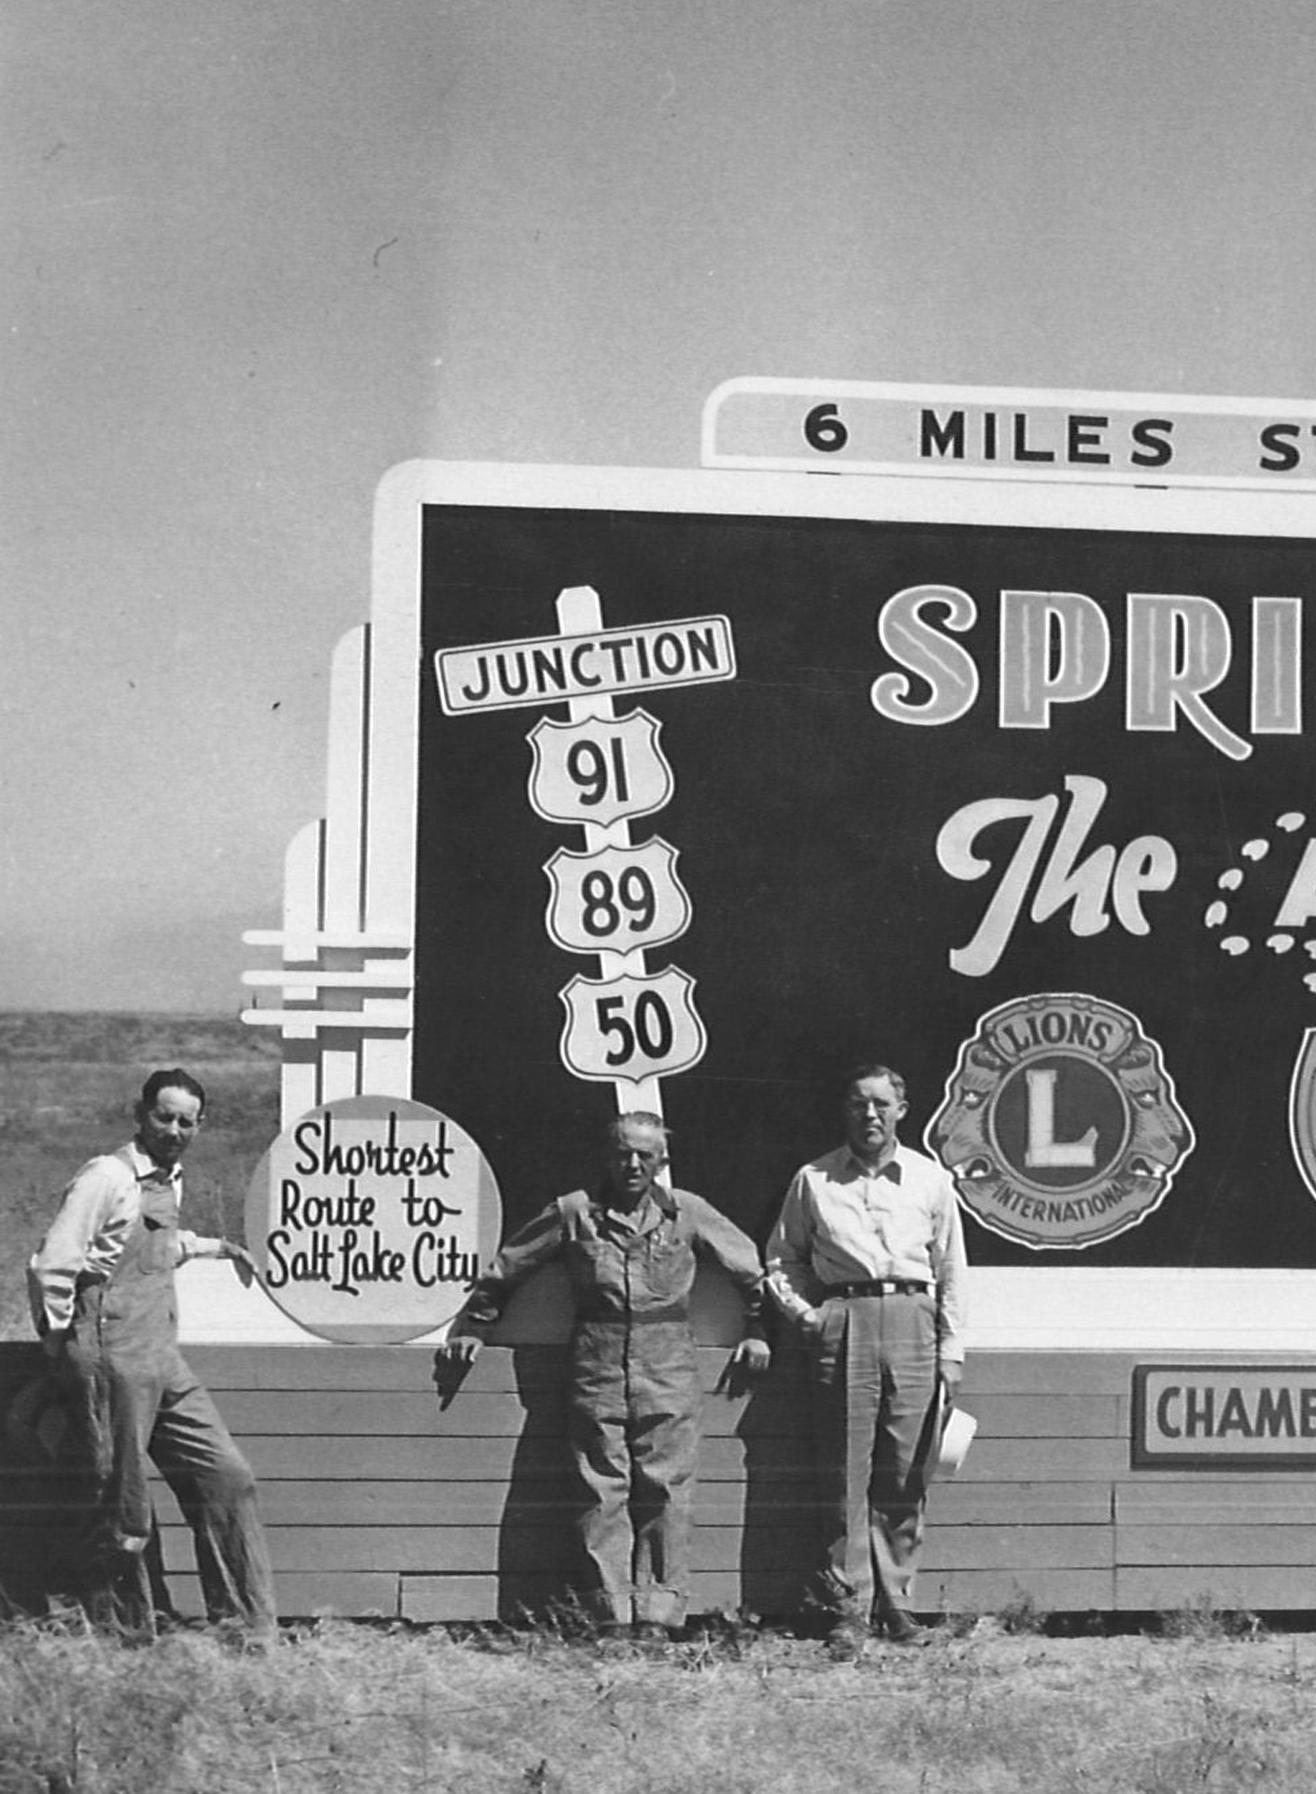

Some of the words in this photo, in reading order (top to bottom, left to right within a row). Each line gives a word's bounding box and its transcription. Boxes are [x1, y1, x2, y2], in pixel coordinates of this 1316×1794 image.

[803, 403, 847, 452] 6
[920, 408, 1174, 467] MILES
[461, 626, 719, 702] JUNCTION
[566, 737, 629, 806] 91
[581, 866, 656, 937] 89
[936, 774, 1178, 976] The
[595, 990, 673, 1066] 50
[1003, 1011, 1114, 1050] LIONS
[294, 1110, 455, 1179] Shortest
[1024, 1068, 1099, 1168] L
[280, 1177, 376, 1231] Route
[991, 1180, 1132, 1223] INTERNATIONAL
[265, 1230, 335, 1289] Salt
[331, 1228, 406, 1297] Lake
[412, 1231, 479, 1293] City
